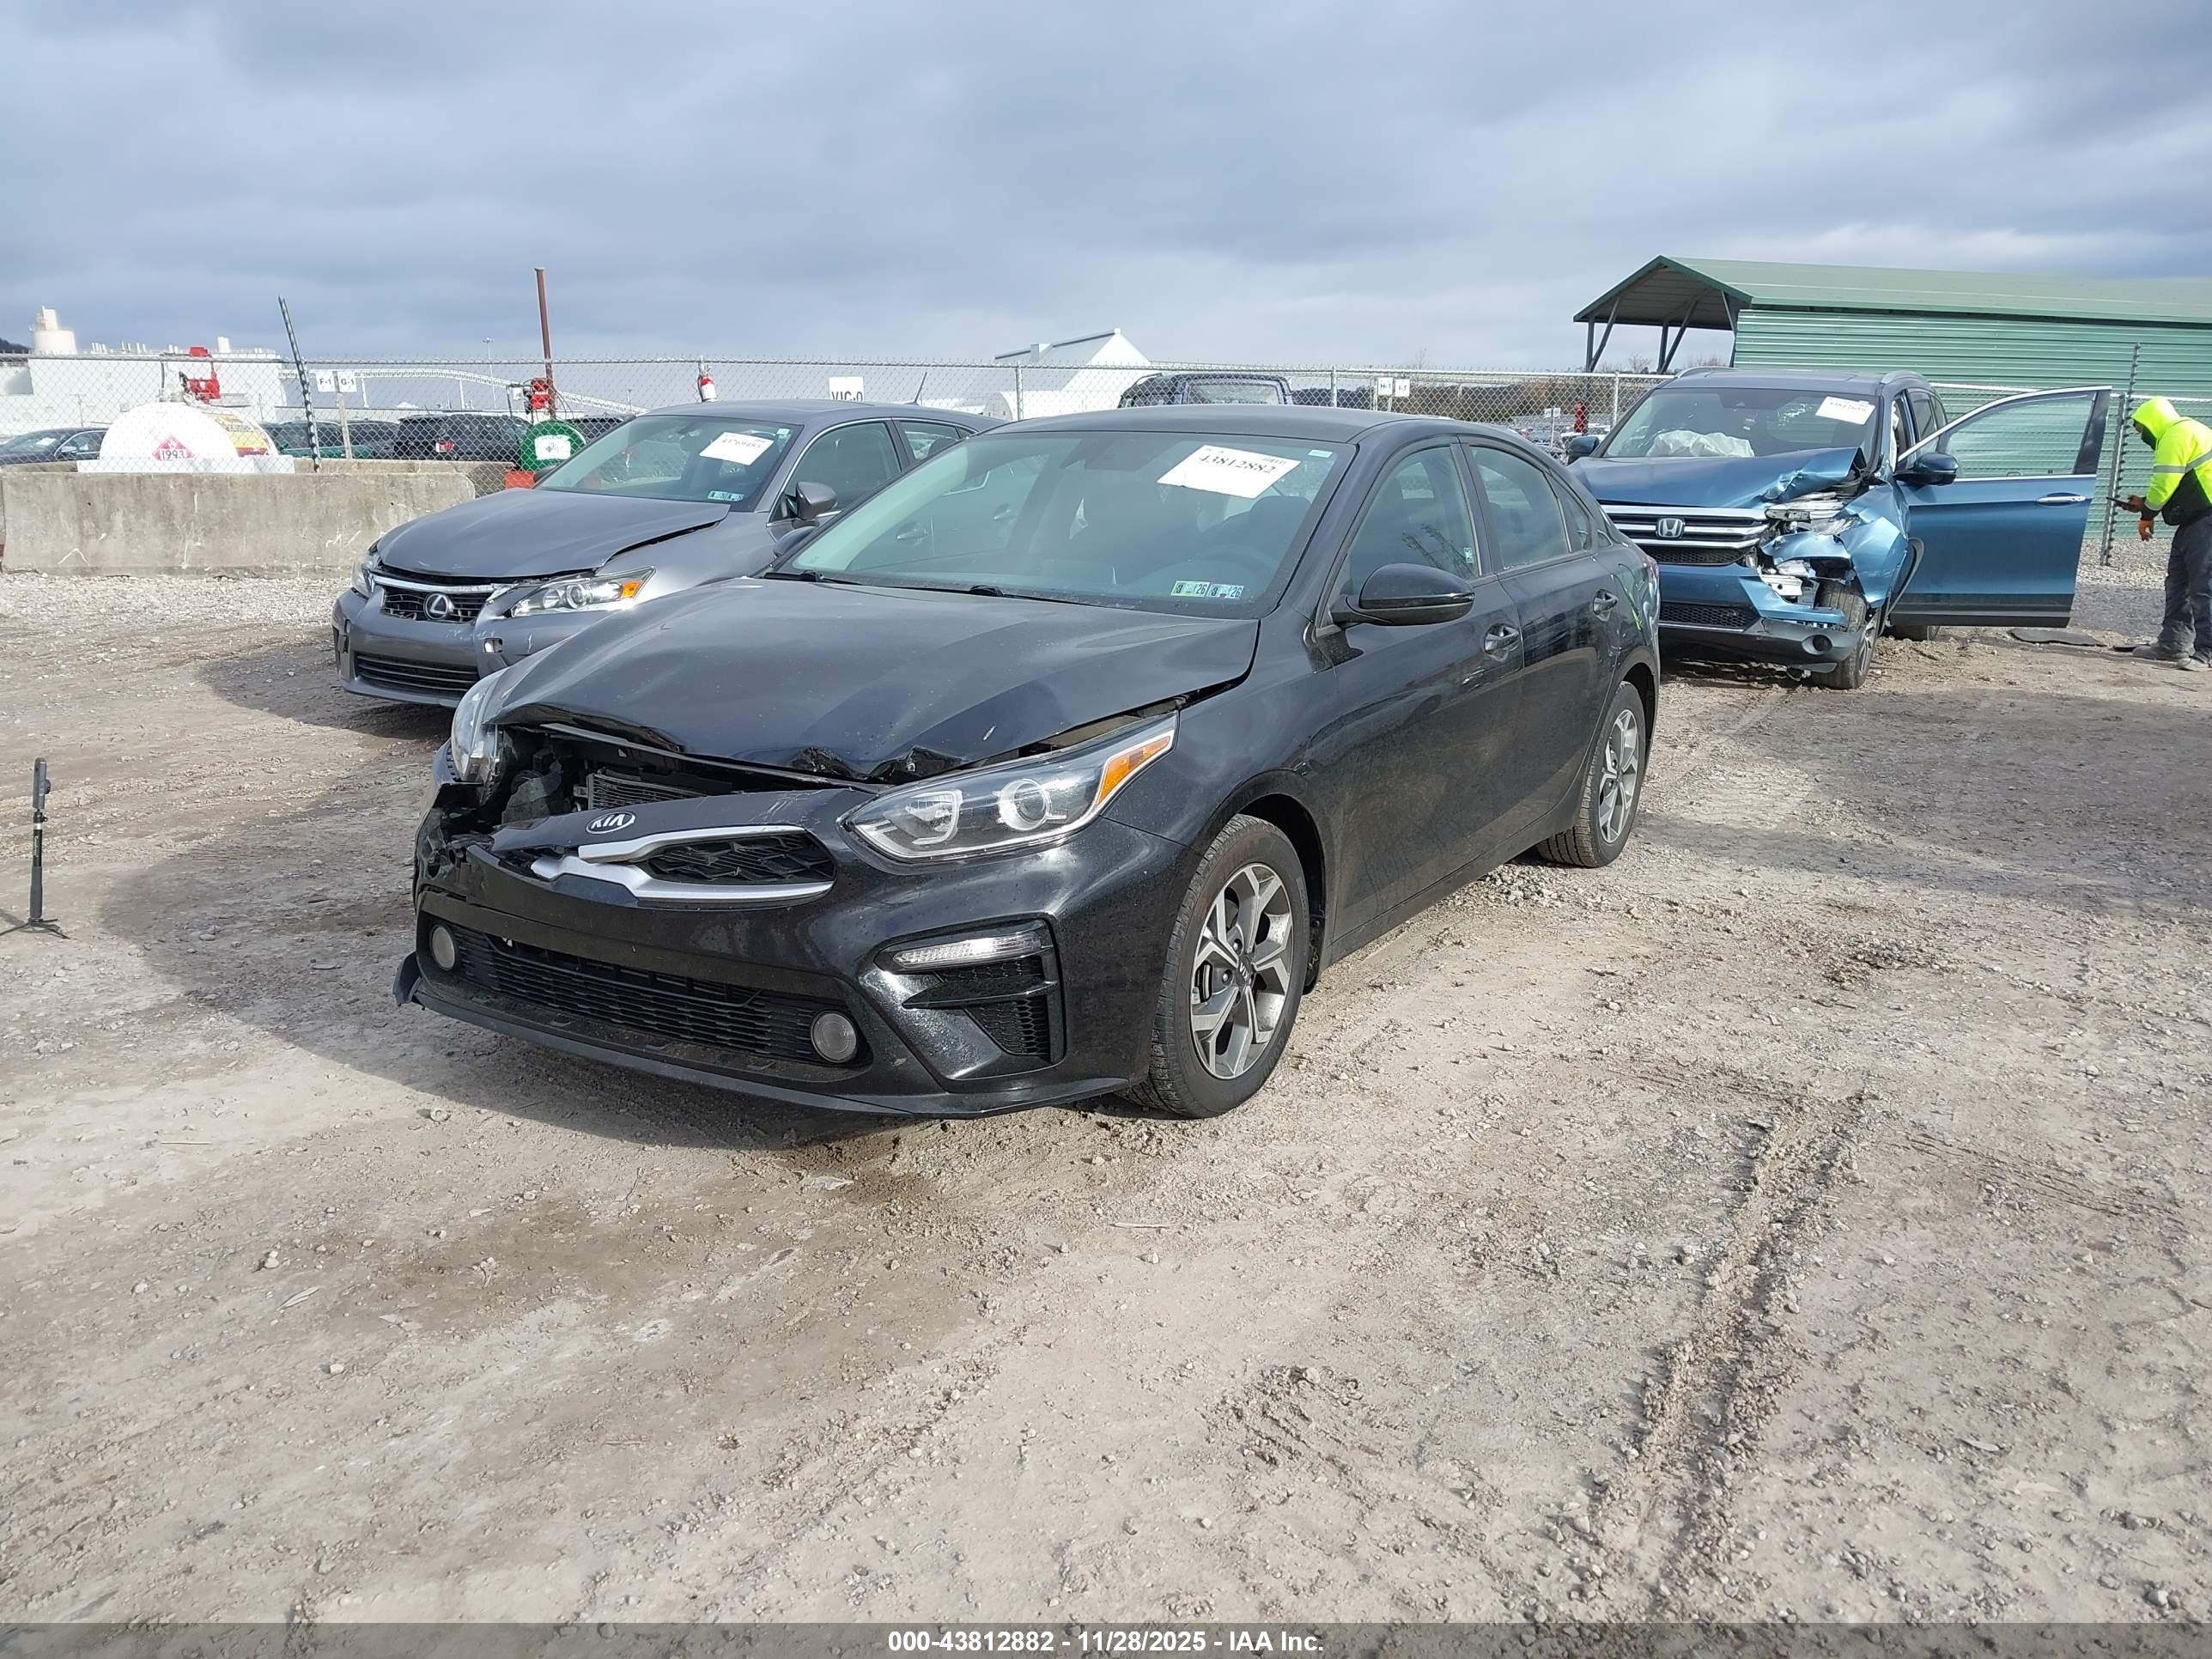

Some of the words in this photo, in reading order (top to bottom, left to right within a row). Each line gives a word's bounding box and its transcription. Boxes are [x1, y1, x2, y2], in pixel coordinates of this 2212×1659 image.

[161, 449, 185, 461] 1993
[1198, 454, 1277, 474] 43812882
[590, 813, 626, 830] KIA
